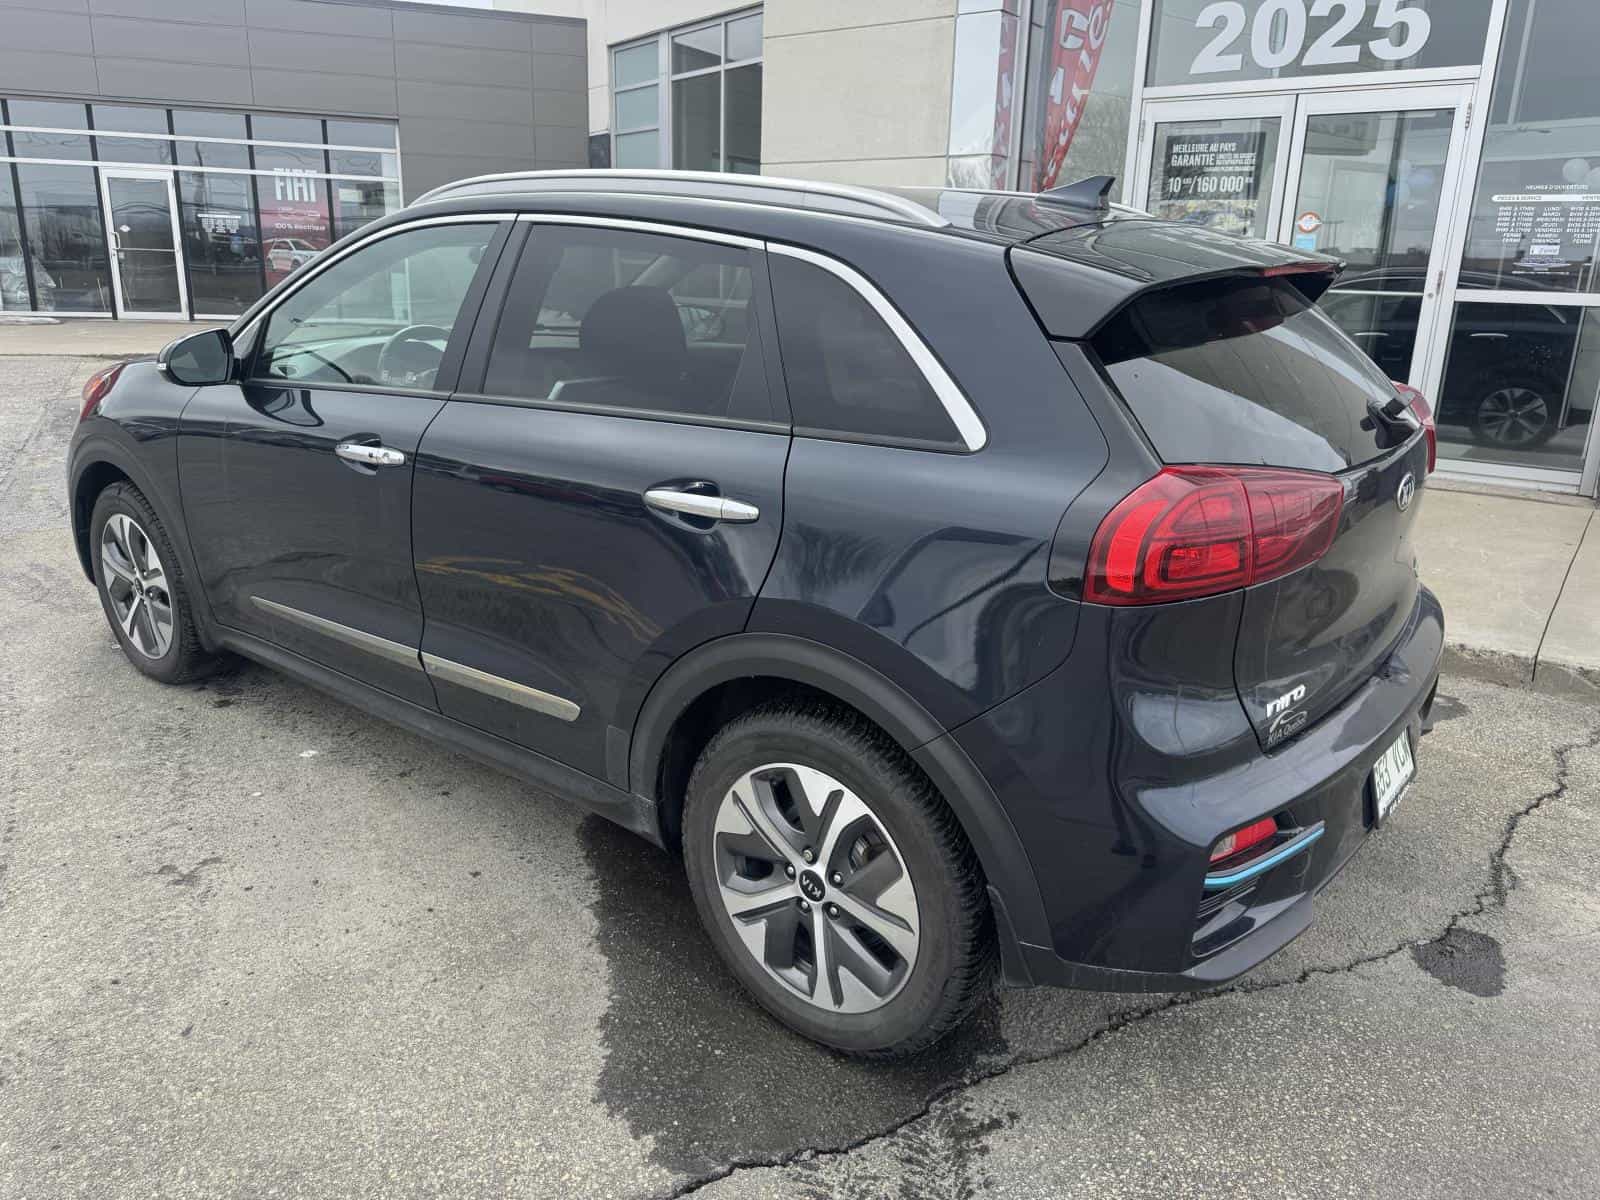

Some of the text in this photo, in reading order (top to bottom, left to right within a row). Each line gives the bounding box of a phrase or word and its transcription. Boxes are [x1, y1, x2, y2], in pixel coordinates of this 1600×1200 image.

[1189, 0, 1431, 74] 2025
[1209, 143, 1219, 152] AU
[1219, 142, 1237, 152] PAYS
[1171, 153, 1216, 167] GARANTIE
[273, 168, 317, 202] FIAT
[1168, 177, 1181, 192] 10
[1219, 175, 1244, 192] 000
[802, 874, 822, 898] KIA
